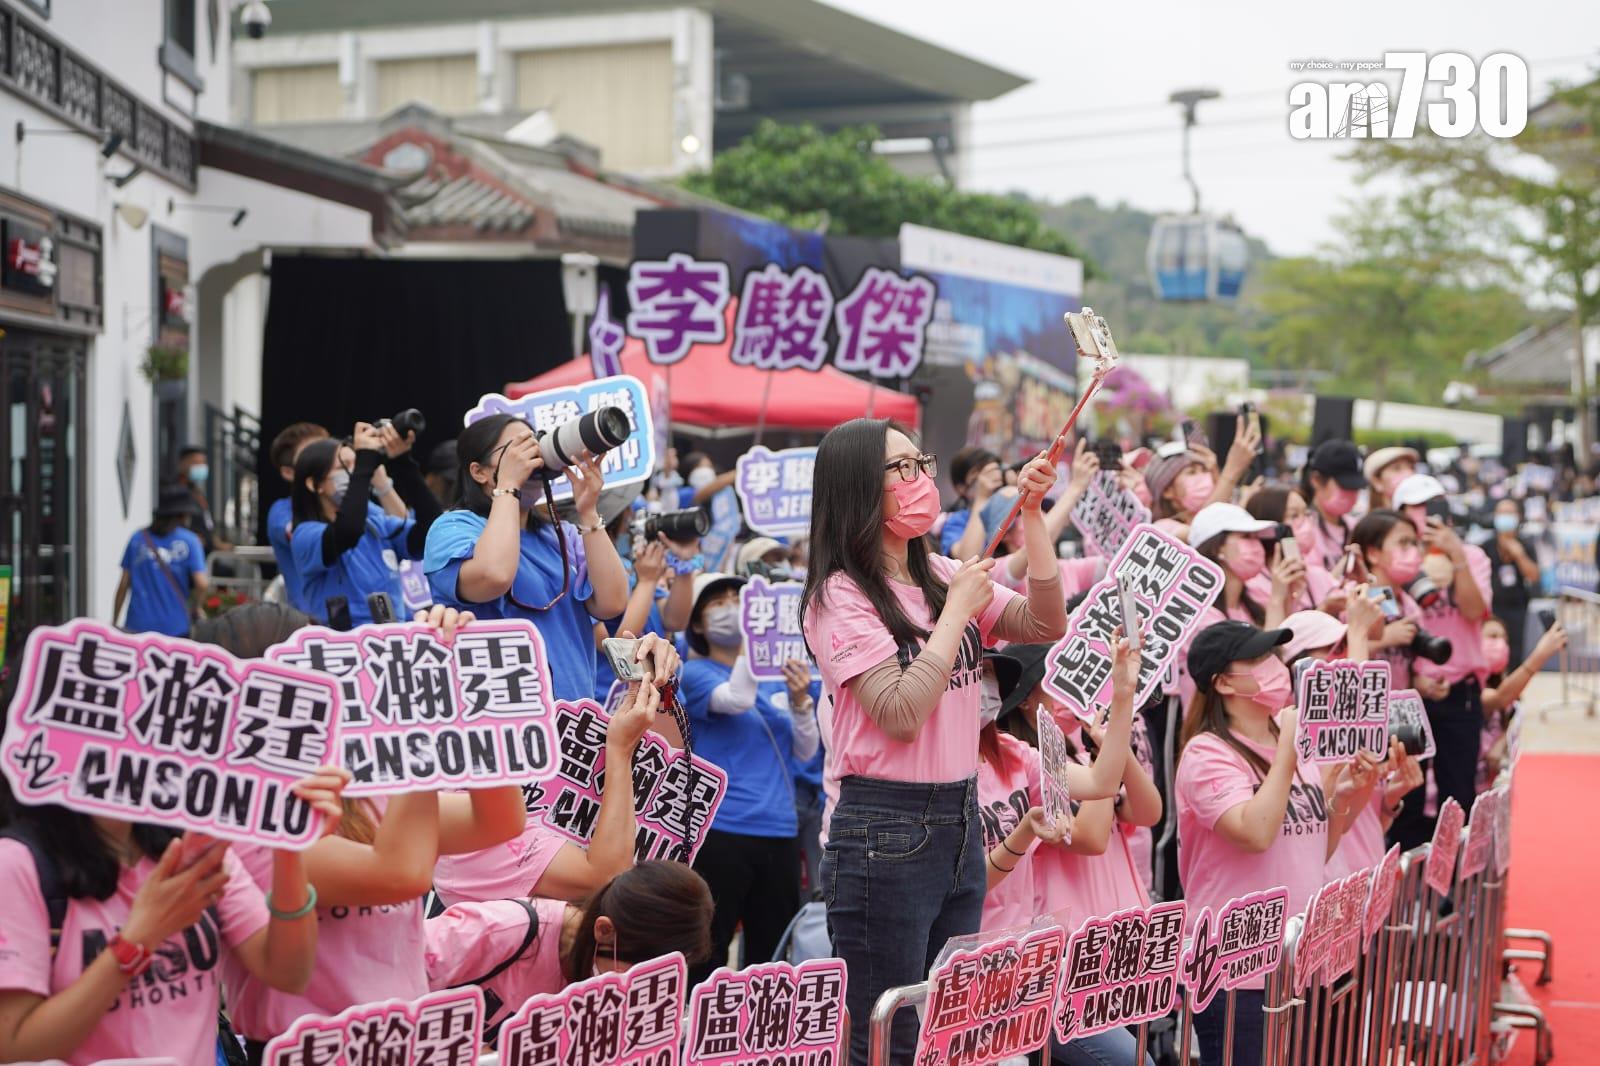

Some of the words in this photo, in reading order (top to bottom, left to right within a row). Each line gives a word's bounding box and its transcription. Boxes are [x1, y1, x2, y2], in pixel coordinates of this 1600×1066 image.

[629, 255, 934, 376] 李駿傑
[1180, 564, 1217, 604] LO
[31, 638, 332, 773] 盧瀚霆
[1304, 669, 1387, 721] 盧瀚霆
[344, 726, 500, 784] ANSON
[505, 724, 548, 773] LO
[1318, 727, 1366, 758] ANSON
[1369, 726, 1384, 755] LO
[79, 747, 252, 828] ANSON
[260, 783, 311, 836] LO
[1067, 909, 1182, 994] 盧瀚霆
[1219, 899, 1284, 955] 盧瀚霆
[930, 937, 1061, 1033] 盧瀚霆
[1228, 951, 1264, 980] ANSON
[1266, 944, 1279, 965] LO
[508, 968, 678, 1066] 盧瀚霆
[694, 971, 842, 1060] 盧瀚霆
[1082, 985, 1152, 1029] ANSON
[1153, 976, 1172, 1013] LO
[948, 1015, 1021, 1066] ANSON
[1023, 1007, 1050, 1047] LO
